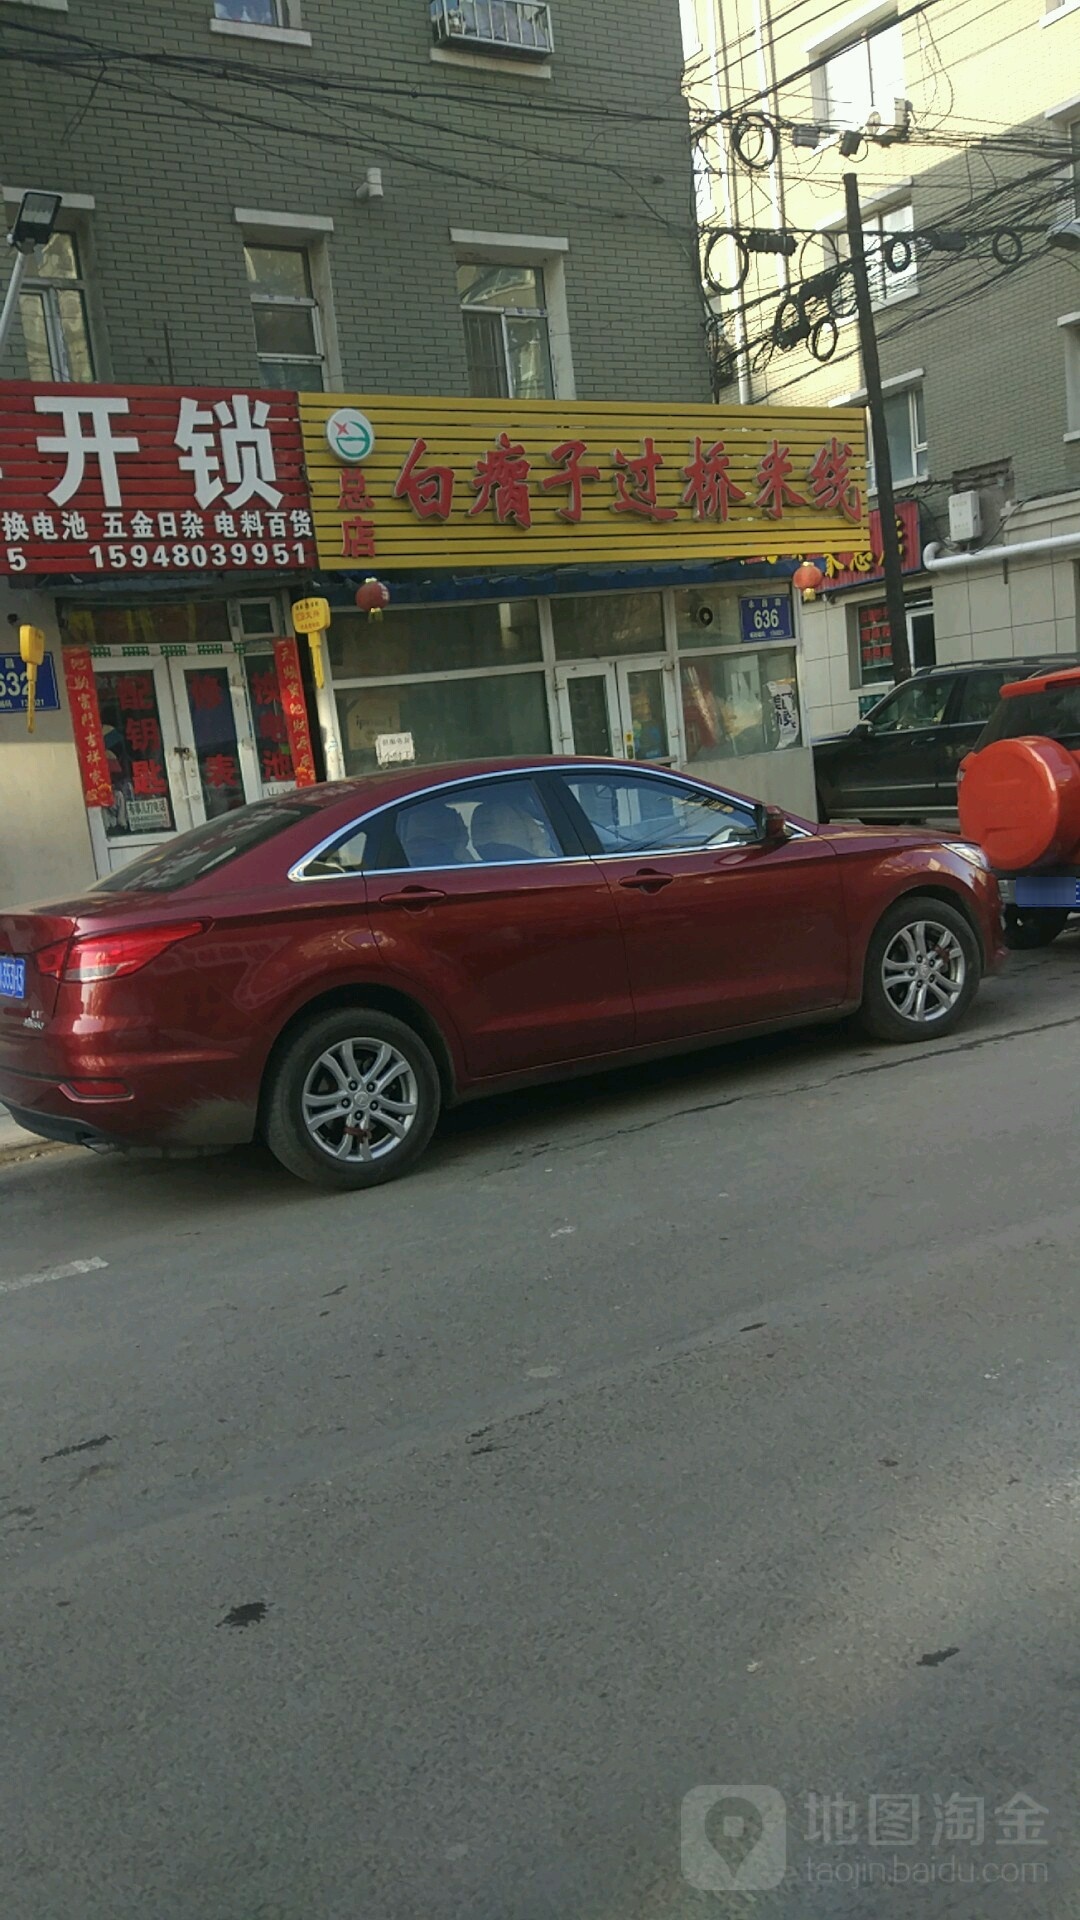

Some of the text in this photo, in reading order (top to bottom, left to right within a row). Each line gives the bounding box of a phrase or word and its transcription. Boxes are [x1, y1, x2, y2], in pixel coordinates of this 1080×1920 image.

[33, 394, 284, 510] 开锁
[1, 509, 313, 541] 换电池 五金日杂 电料百货
[337, 466, 376, 559] 总店
[7, 543, 306, 572] 5 15948039951
[753, 608, 780, 630] 636
